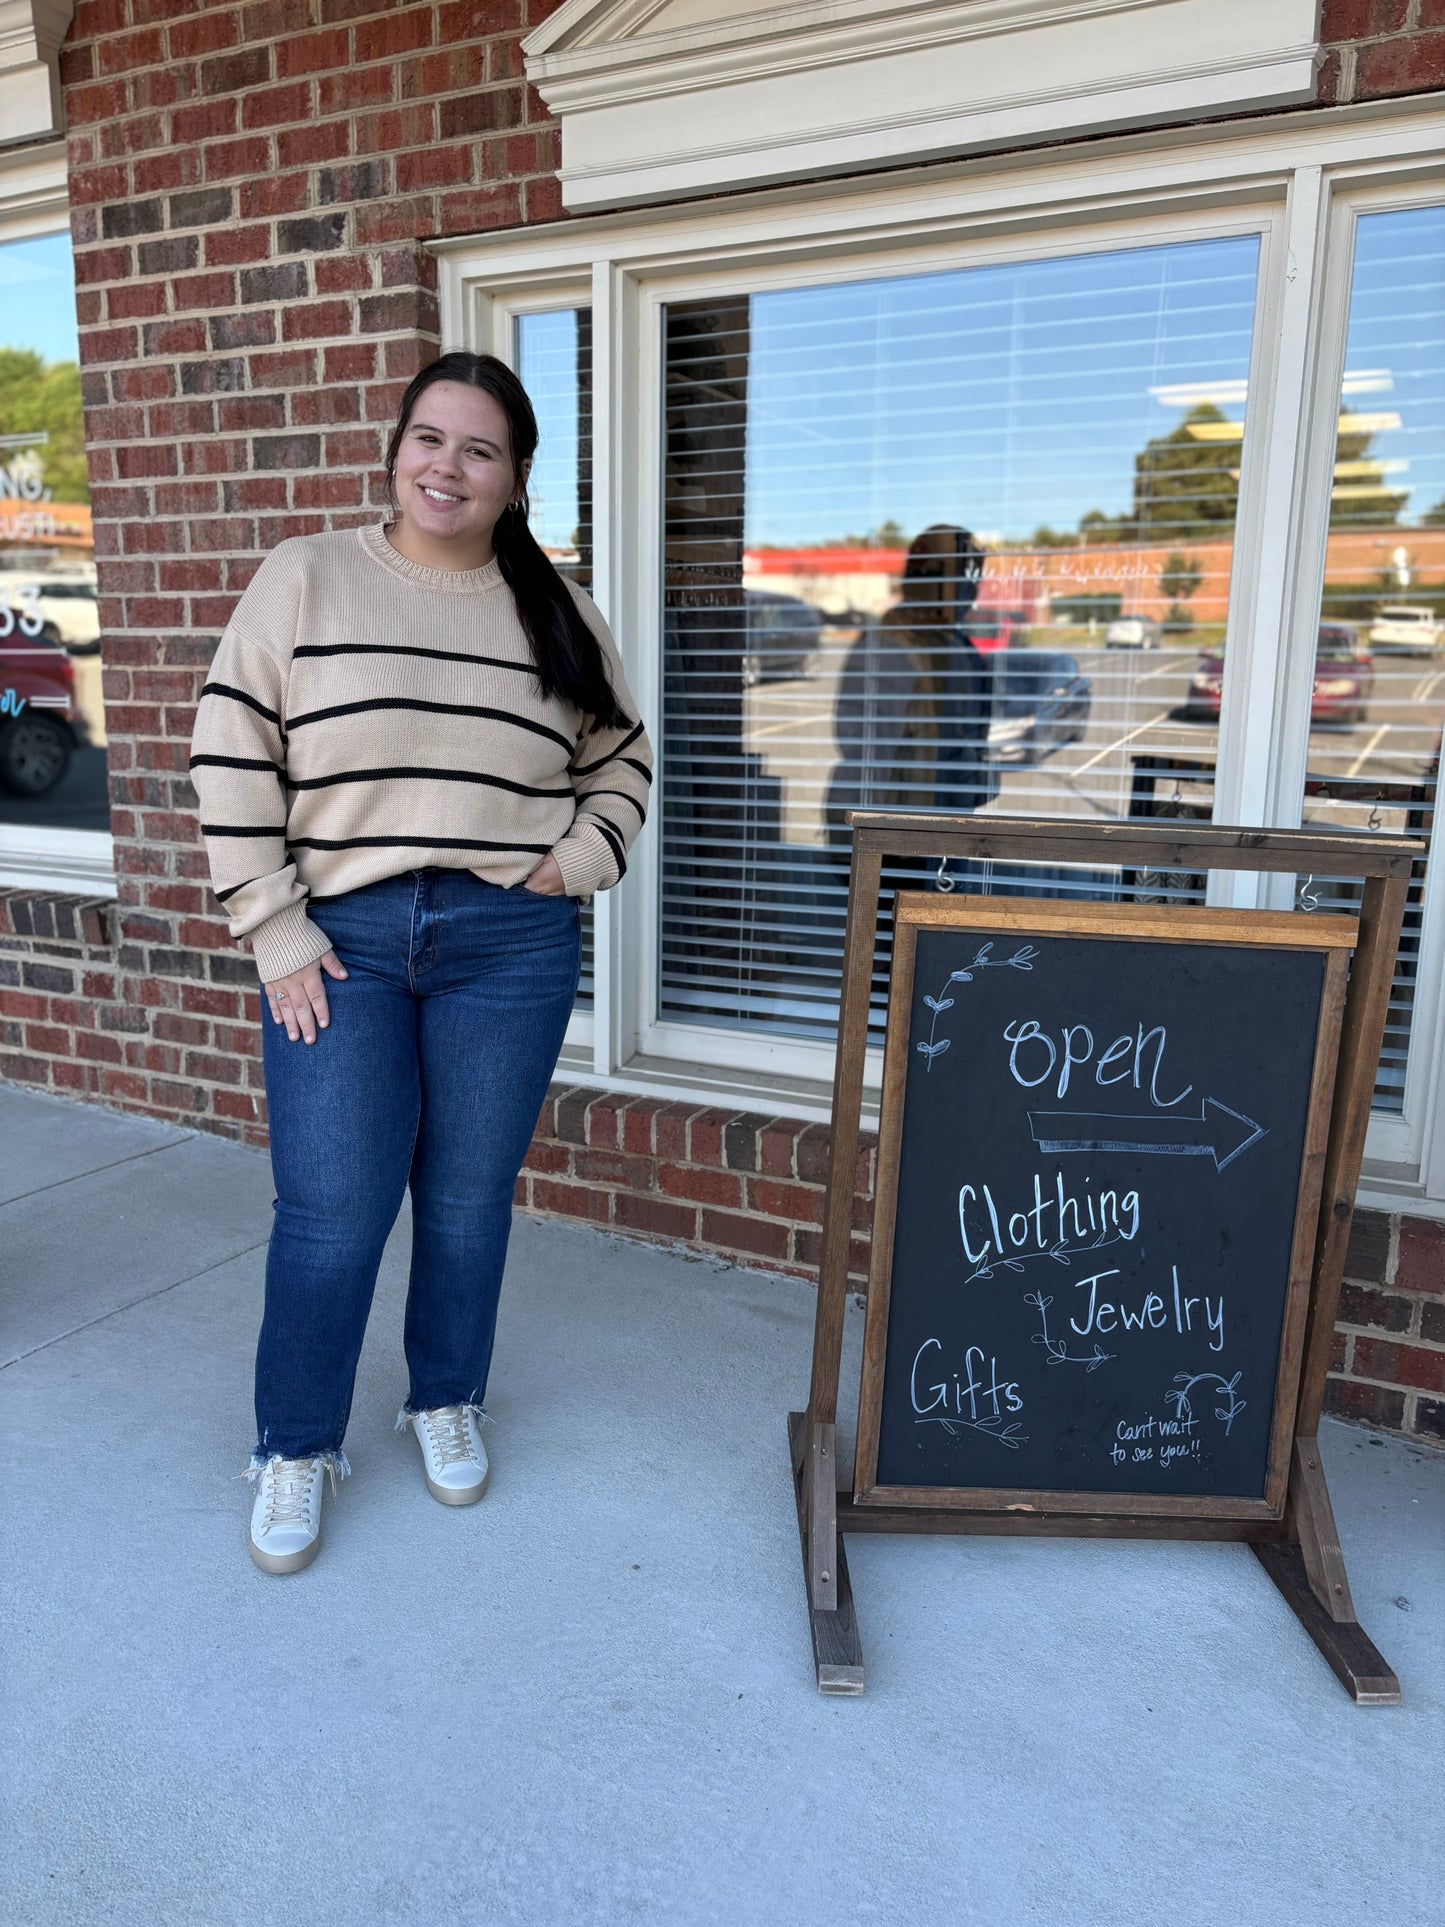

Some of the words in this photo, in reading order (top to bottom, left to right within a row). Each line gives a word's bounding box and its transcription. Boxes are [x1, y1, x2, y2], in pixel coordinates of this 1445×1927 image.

[1003, 1020, 1192, 1107] Open
[959, 1172, 1140, 1263] Clothing
[1070, 1265, 1224, 1351] Jewelry
[911, 1338, 1023, 1419] Gifts
[1109, 1442, 1126, 1465] to
[1132, 1446, 1153, 1462] see
[1160, 1440, 1200, 1468] you!!
[1159, 1412, 1200, 1436] wait
